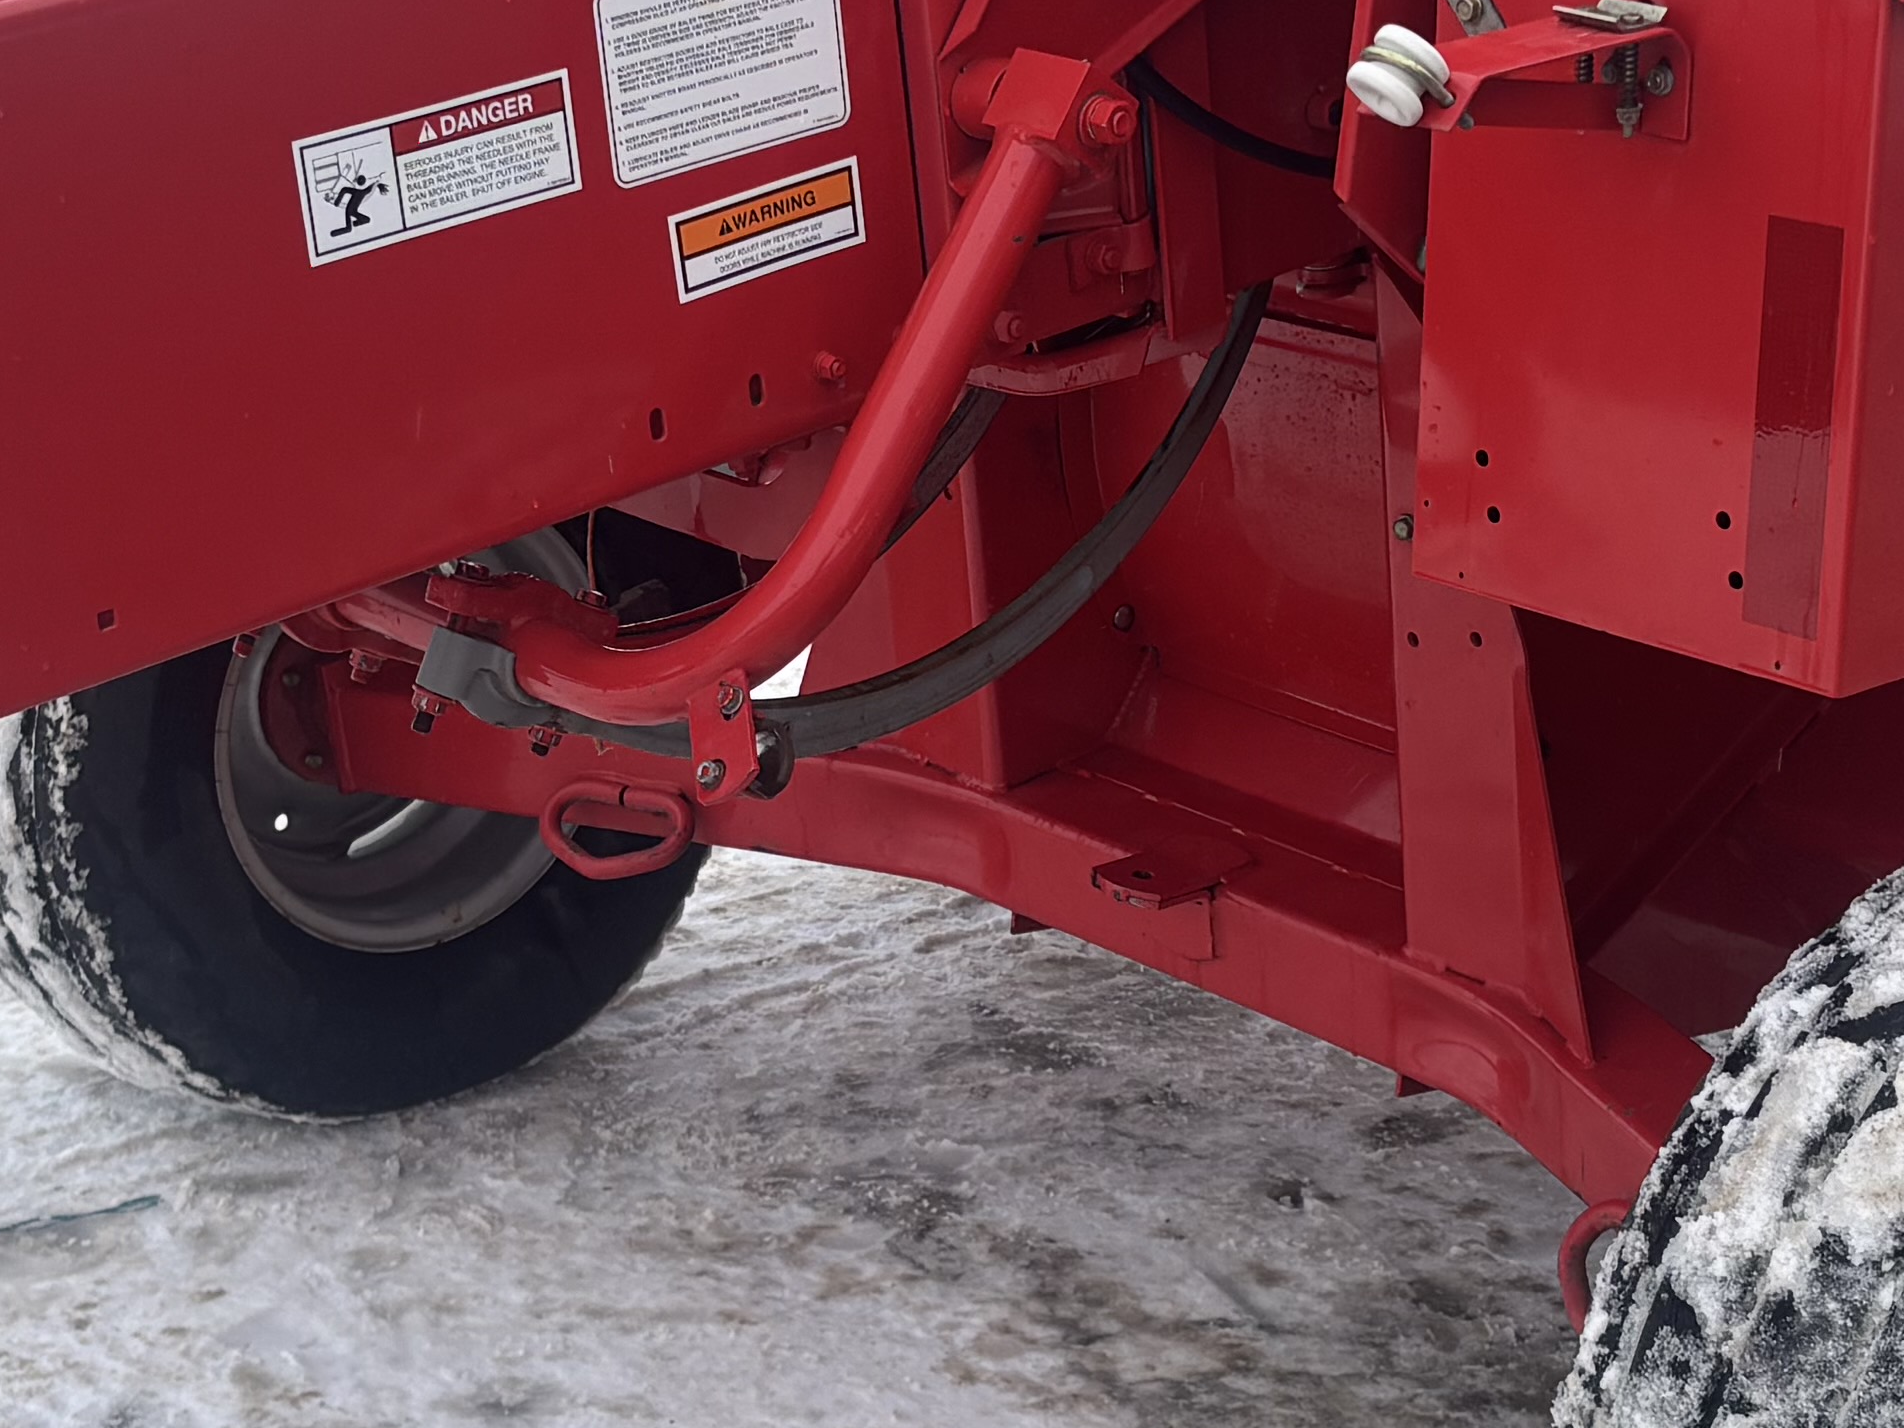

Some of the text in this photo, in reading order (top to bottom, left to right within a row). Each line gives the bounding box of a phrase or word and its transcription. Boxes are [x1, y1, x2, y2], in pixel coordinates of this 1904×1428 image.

[439, 92, 533, 137] DANGER
[456, 154, 473, 167] THE
[475, 143, 514, 162] NEEDLES
[514, 137, 537, 151] WITH
[539, 132, 554, 145] THE
[475, 138, 494, 151] CAN
[494, 129, 527, 146] RESULT
[529, 121, 553, 136] FROM
[480, 159, 496, 172] THE
[497, 149, 531, 167] NEEDLE
[532, 141, 560, 157] FRAME
[407, 190, 427, 203] CAN
[454, 171, 493, 190] WITHOUT
[495, 161, 531, 178] PUTTING
[533, 155, 550, 168] HAY
[409, 203, 419, 214] IN
[420, 198, 438, 211] THE
[495, 177, 513, 190] OFF
[732, 188, 816, 231] WARNING
